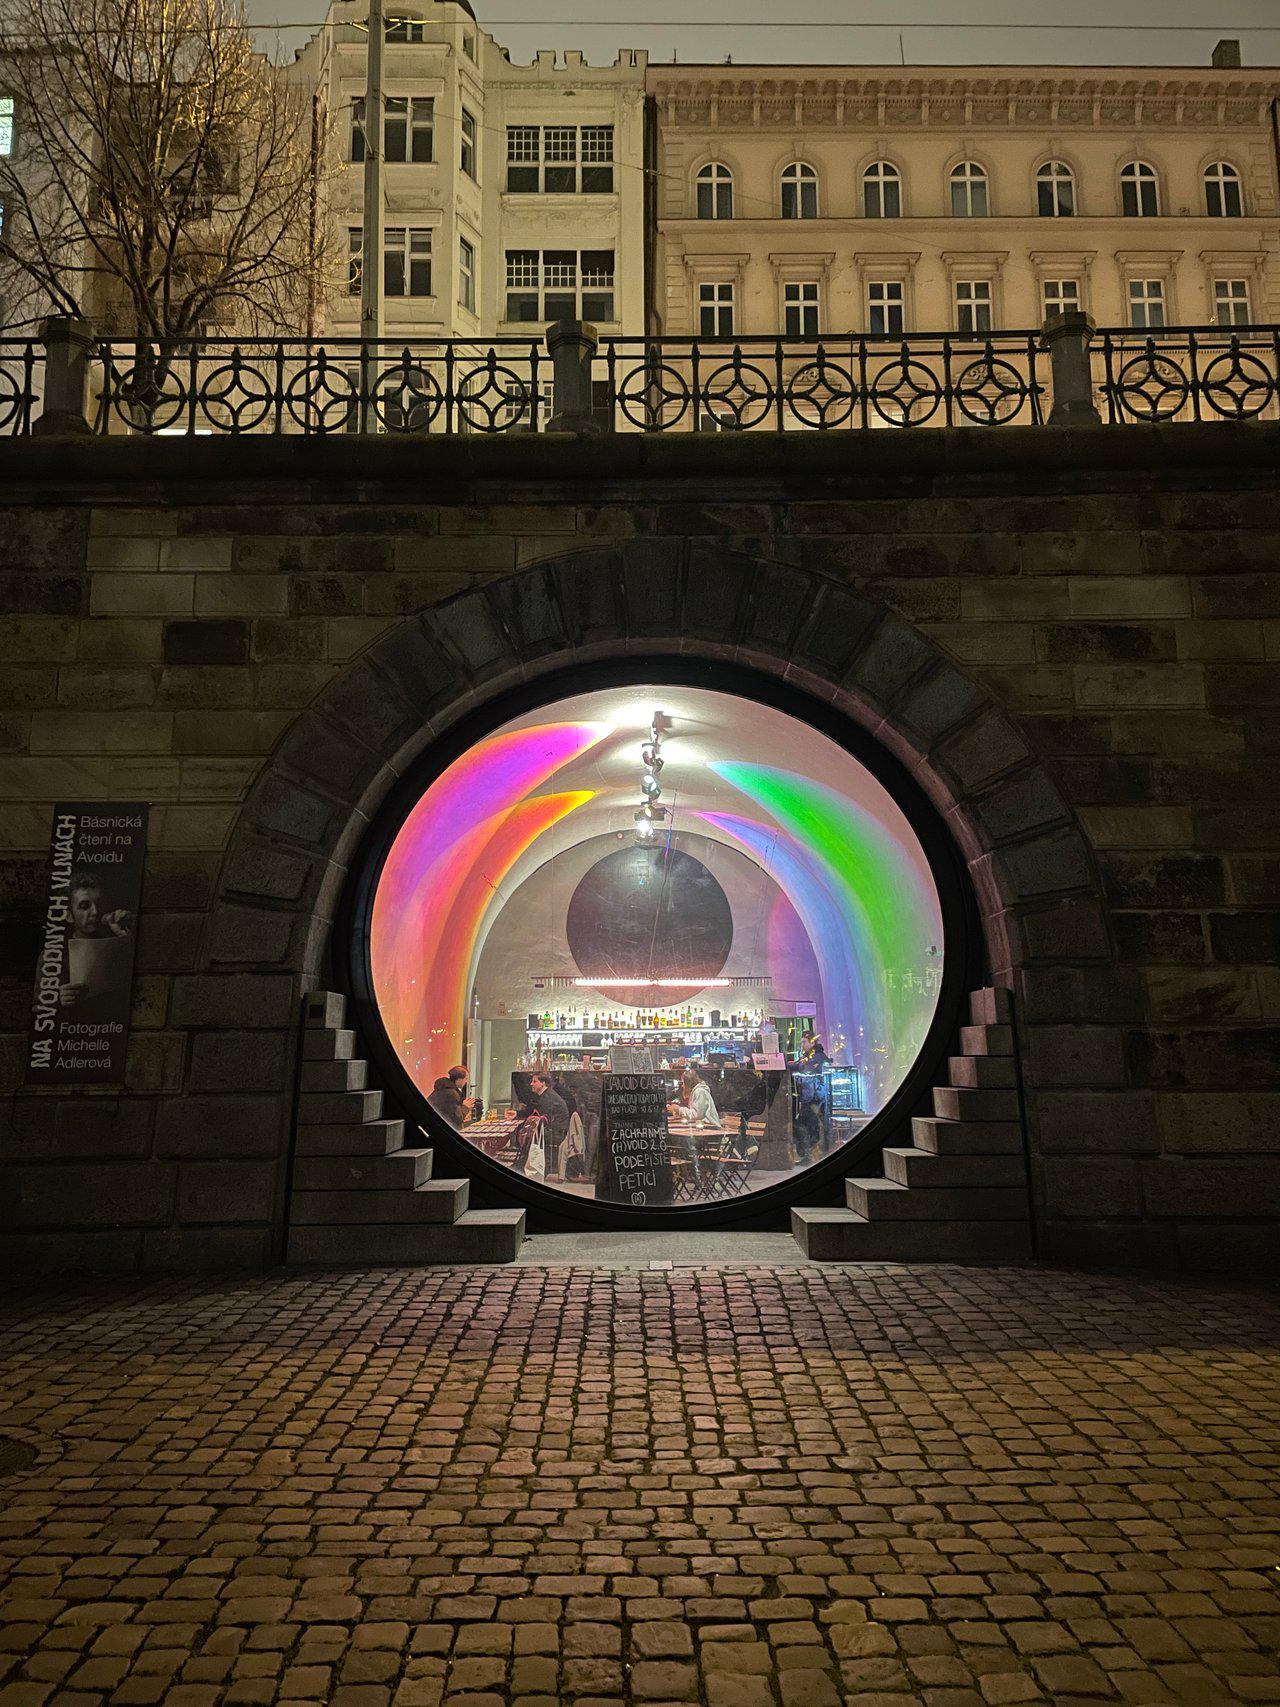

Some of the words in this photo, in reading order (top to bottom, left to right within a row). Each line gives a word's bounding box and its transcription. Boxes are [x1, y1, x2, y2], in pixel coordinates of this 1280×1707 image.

[80, 815, 143, 829] Básnická
[78, 833, 112, 846] čtení
[115, 836, 132, 846] na
[51, 814, 77, 891] VLNÁCH
[76, 851, 124, 864] Avoidu
[34, 896, 69, 1031] SVOBODNÝCH
[59, 1022, 124, 1036] Fotografie
[57, 1039, 110, 1052] Michelle
[30, 1038, 53, 1068] NA
[54, 1056, 112, 1070] Adlerová
